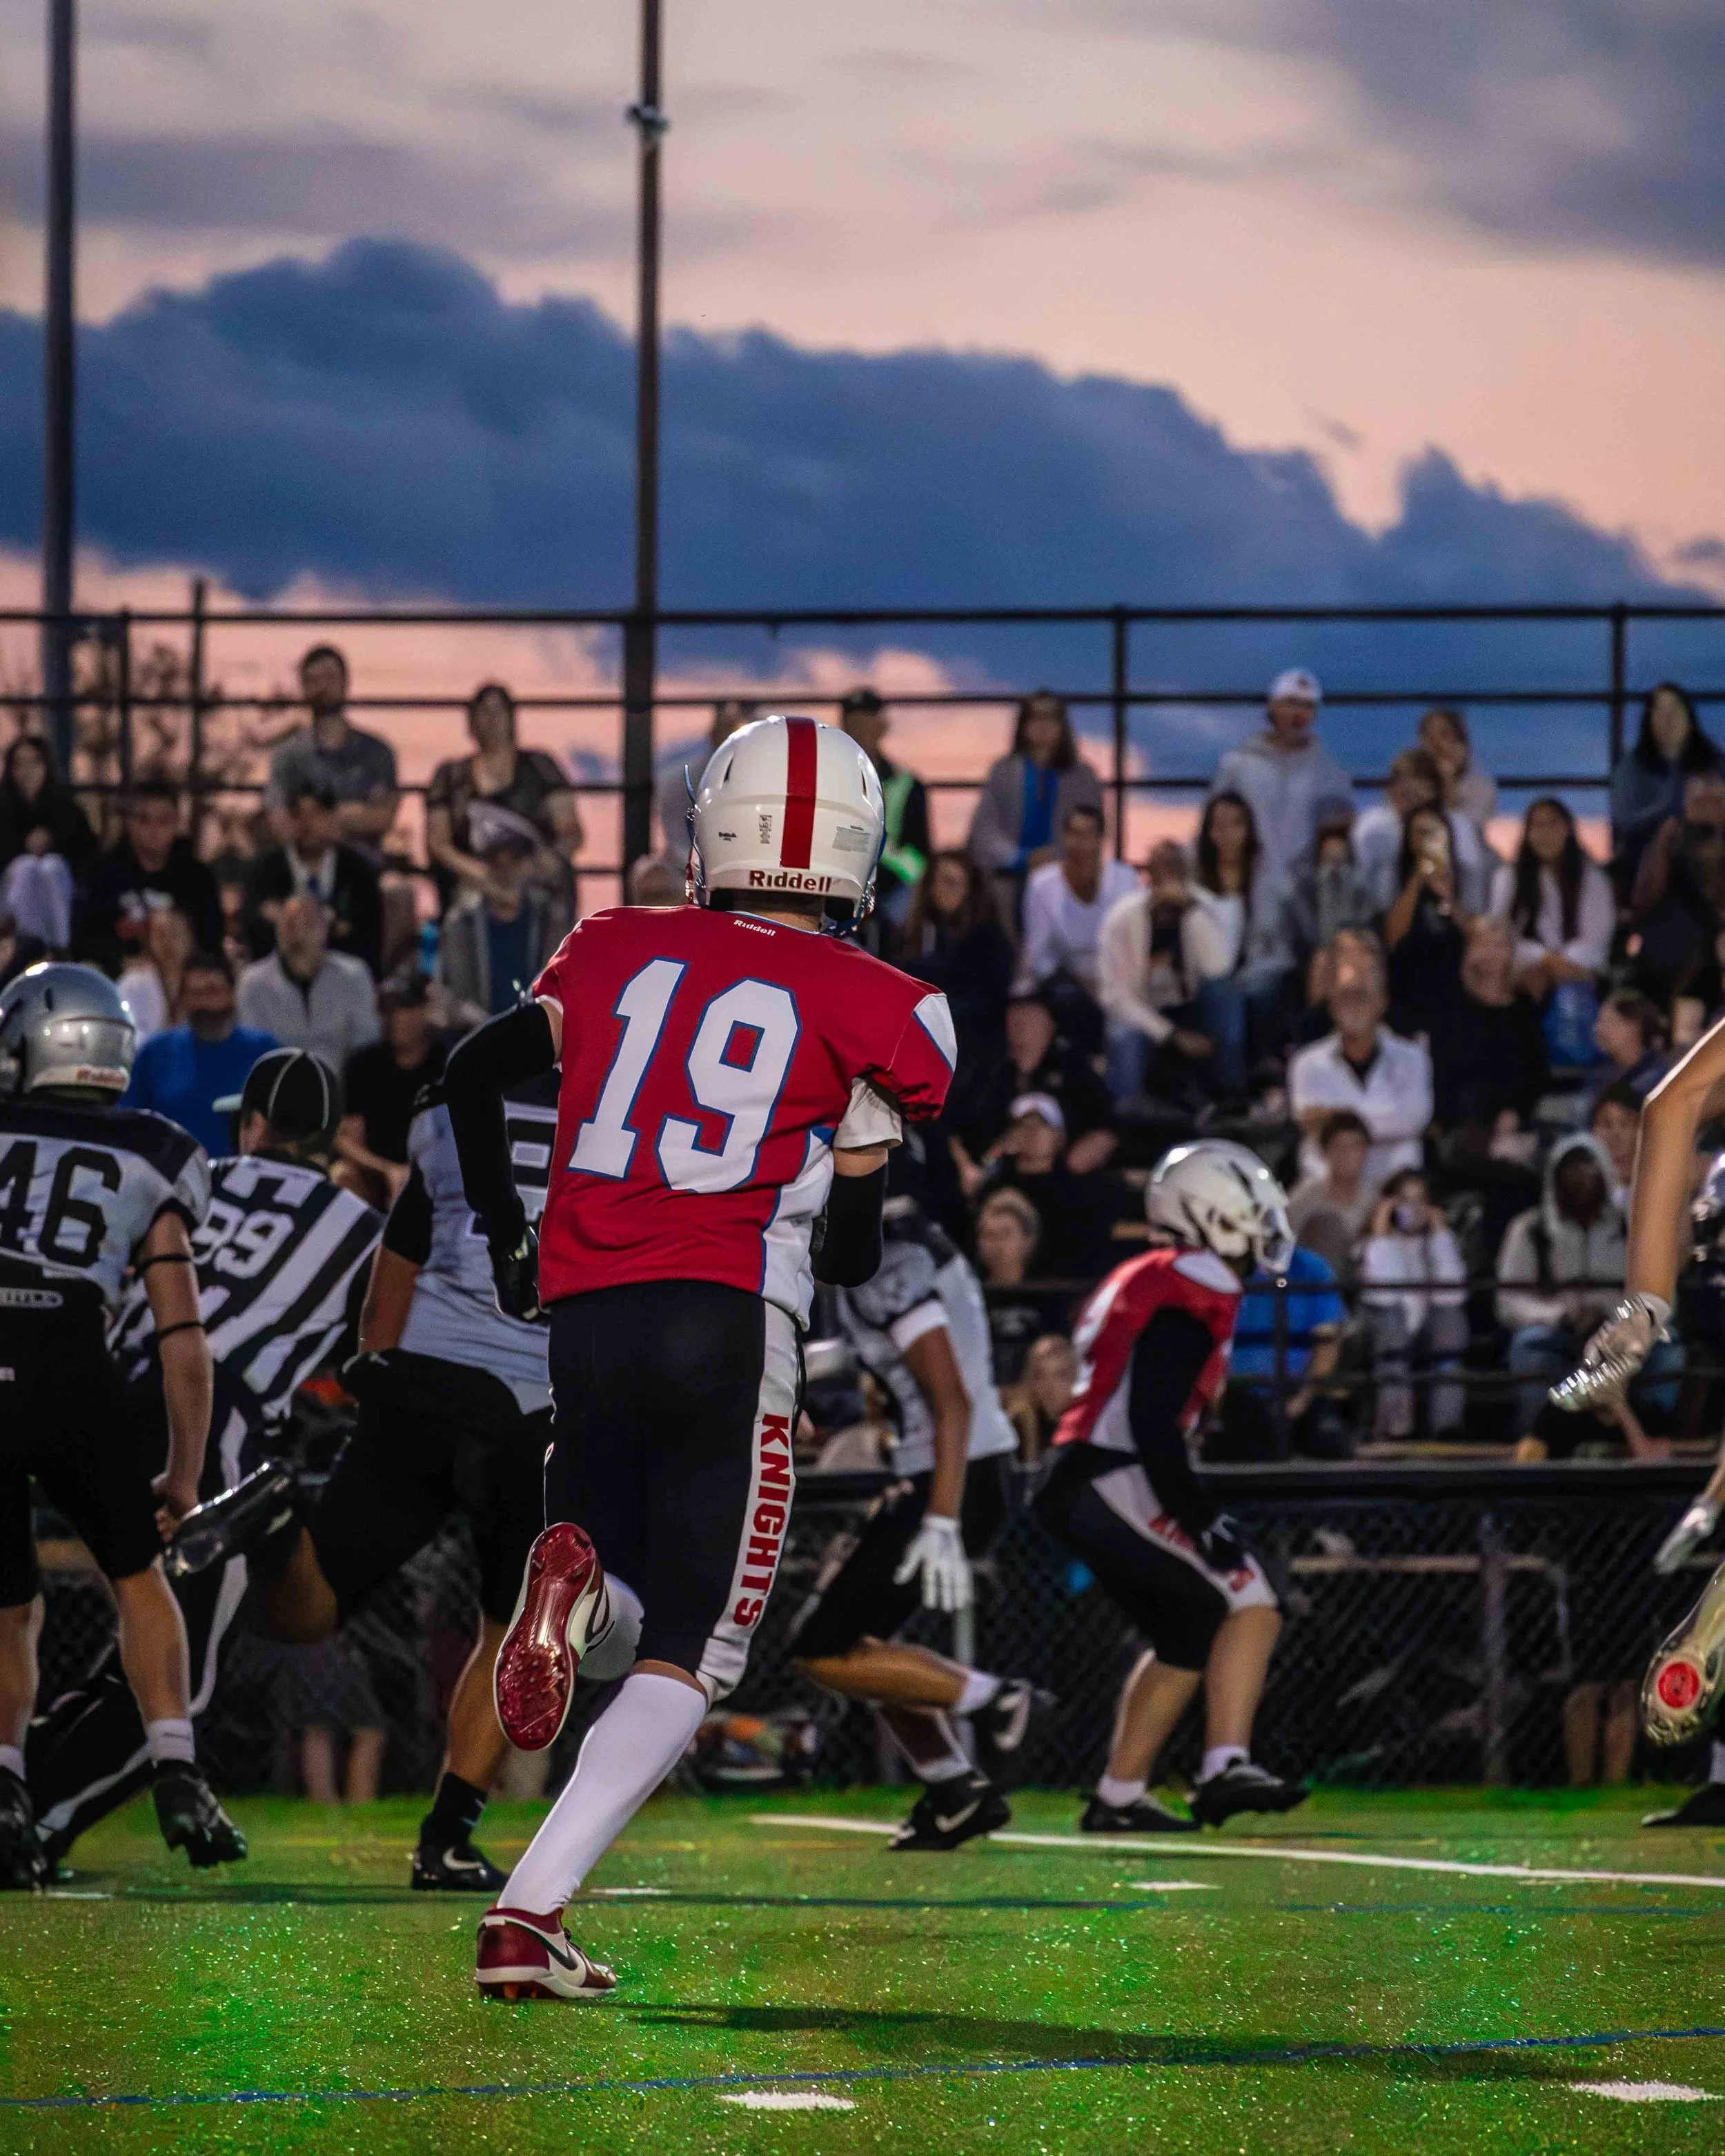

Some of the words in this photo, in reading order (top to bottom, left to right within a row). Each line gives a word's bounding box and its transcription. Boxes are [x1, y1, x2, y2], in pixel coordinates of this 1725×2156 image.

[733, 919, 777, 937] Riddell
[749, 869, 832, 893] Riddell
[566, 955, 803, 1194] 19
[0, 1140, 122, 1268] 46
[733, 1413, 791, 1628] KNIGHTS
